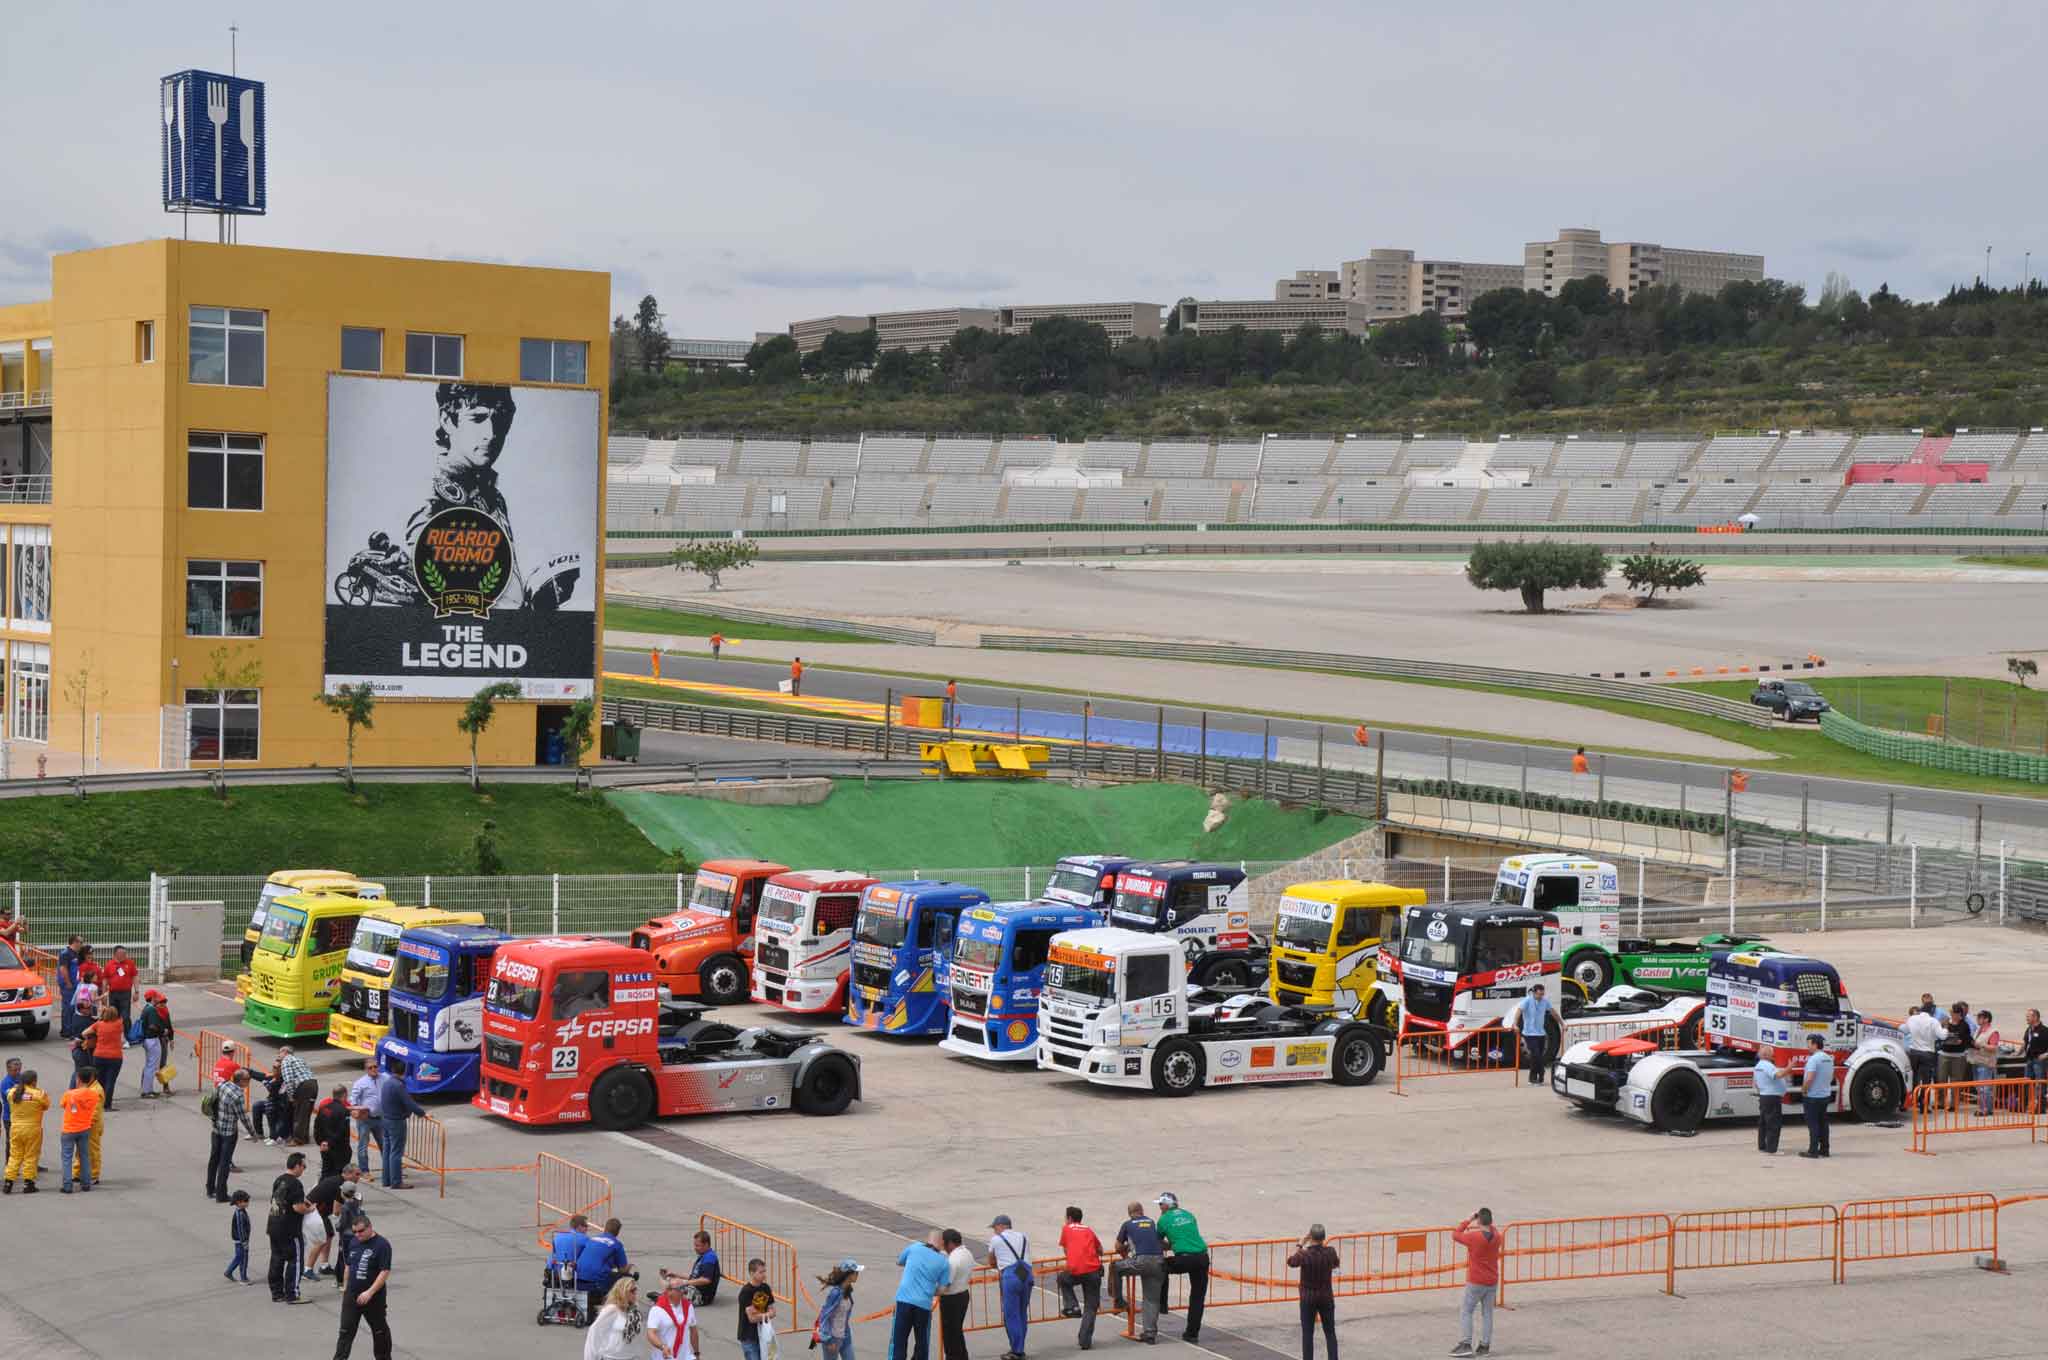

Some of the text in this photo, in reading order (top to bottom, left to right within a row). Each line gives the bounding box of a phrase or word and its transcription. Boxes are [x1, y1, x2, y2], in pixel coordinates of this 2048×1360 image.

[427, 528, 501, 546] RICARDO
[433, 546, 496, 562] TORMO
[441, 625, 484, 642] THE
[401, 643, 528, 668] LEGEND
[1584, 876, 1595, 889] 2
[1216, 895, 1228, 907] 12
[505, 960, 538, 983] CEPSA
[615, 973, 653, 982] MEYLE
[1051, 967, 1061, 985] 15
[1495, 962, 1542, 982] OXXO
[370, 989, 380, 1007] 35
[487, 981, 498, 1000] 23
[627, 990, 653, 999] BOSCH
[1154, 998, 1172, 1014] 15
[588, 1018, 653, 1038] CEPSA
[1711, 1014, 1727, 1030] 55
[1835, 1022, 1855, 1038] 55
[555, 1050, 577, 1068] 23
[559, 1111, 586, 1121] MAHLE
